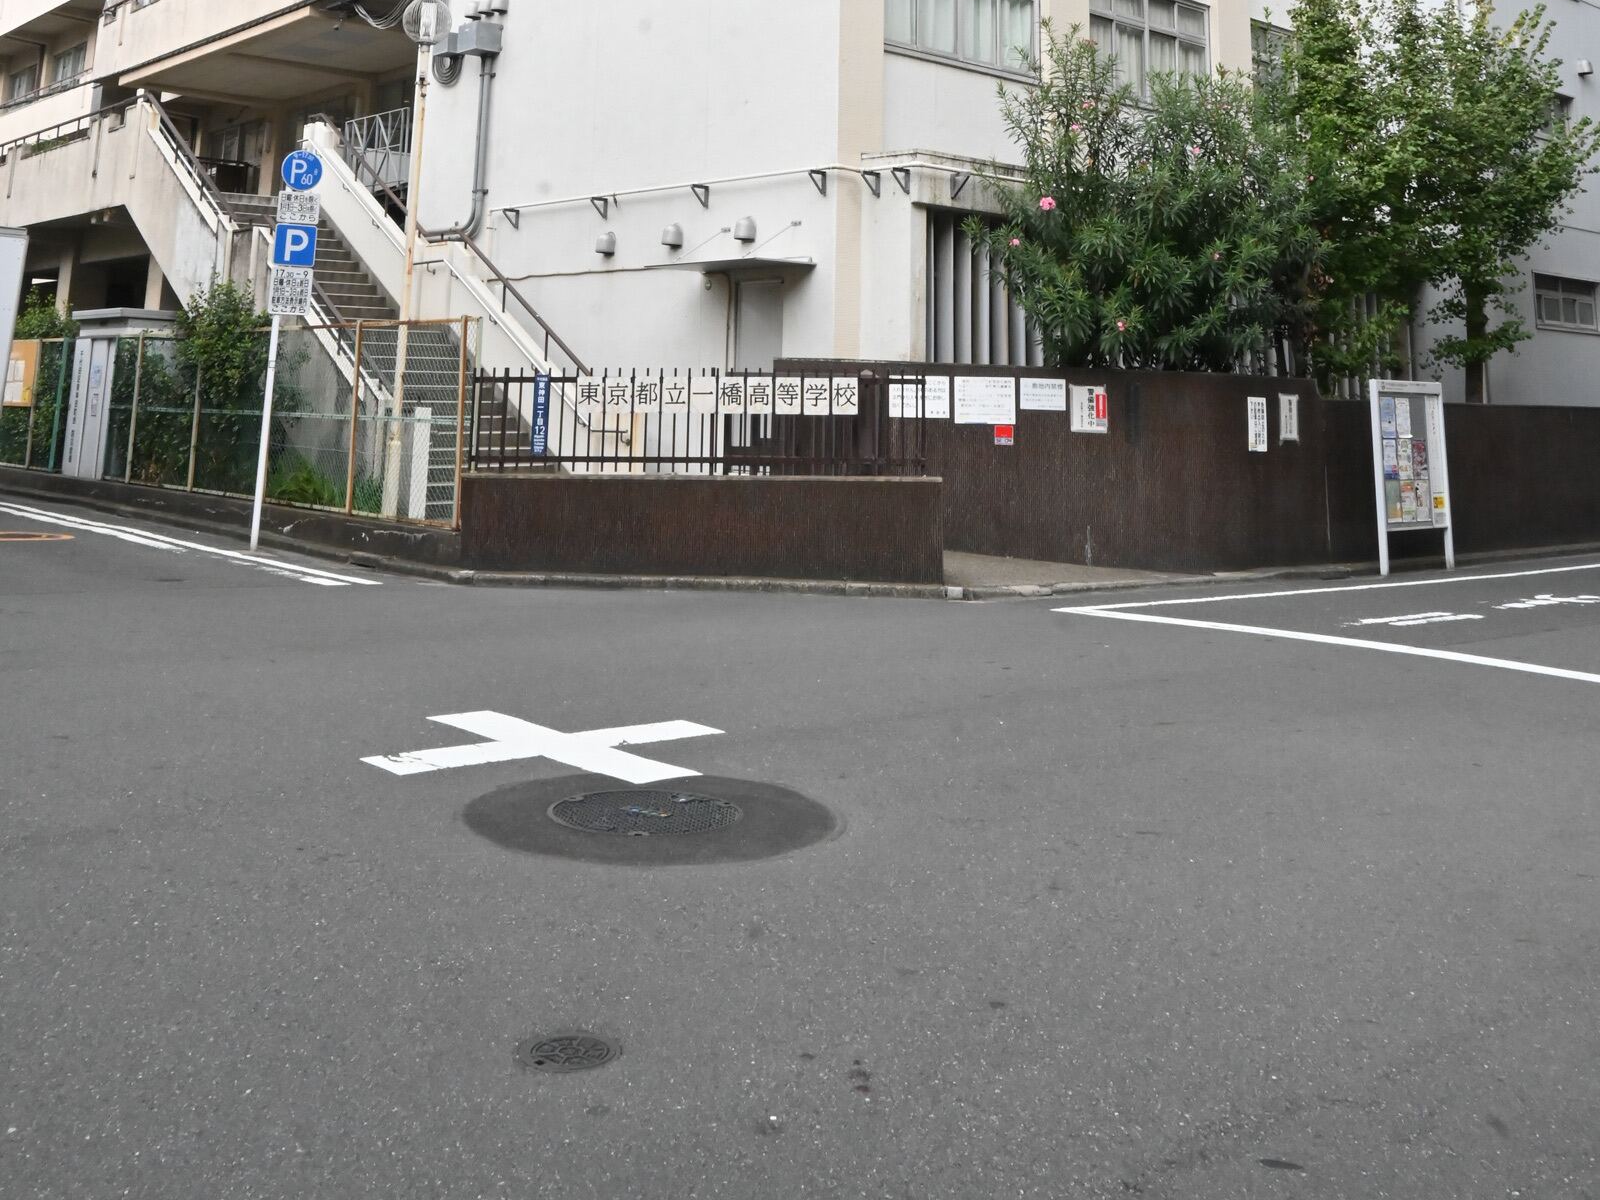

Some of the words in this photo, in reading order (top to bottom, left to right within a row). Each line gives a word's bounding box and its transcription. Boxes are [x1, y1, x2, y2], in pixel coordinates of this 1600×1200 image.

[290, 159, 307, 184] P
[301, 174, 313, 185] 60
[279, 212, 316, 222] ここから
[284, 228, 309, 262] P
[271, 305, 306, 314] ここから
[537, 382, 546, 426] 東神田一丁目
[579, 382, 857, 407] 東京都立一橋高等学校
[1087, 388, 1095, 427] 警備強化中
[535, 426, 545, 435] 12
